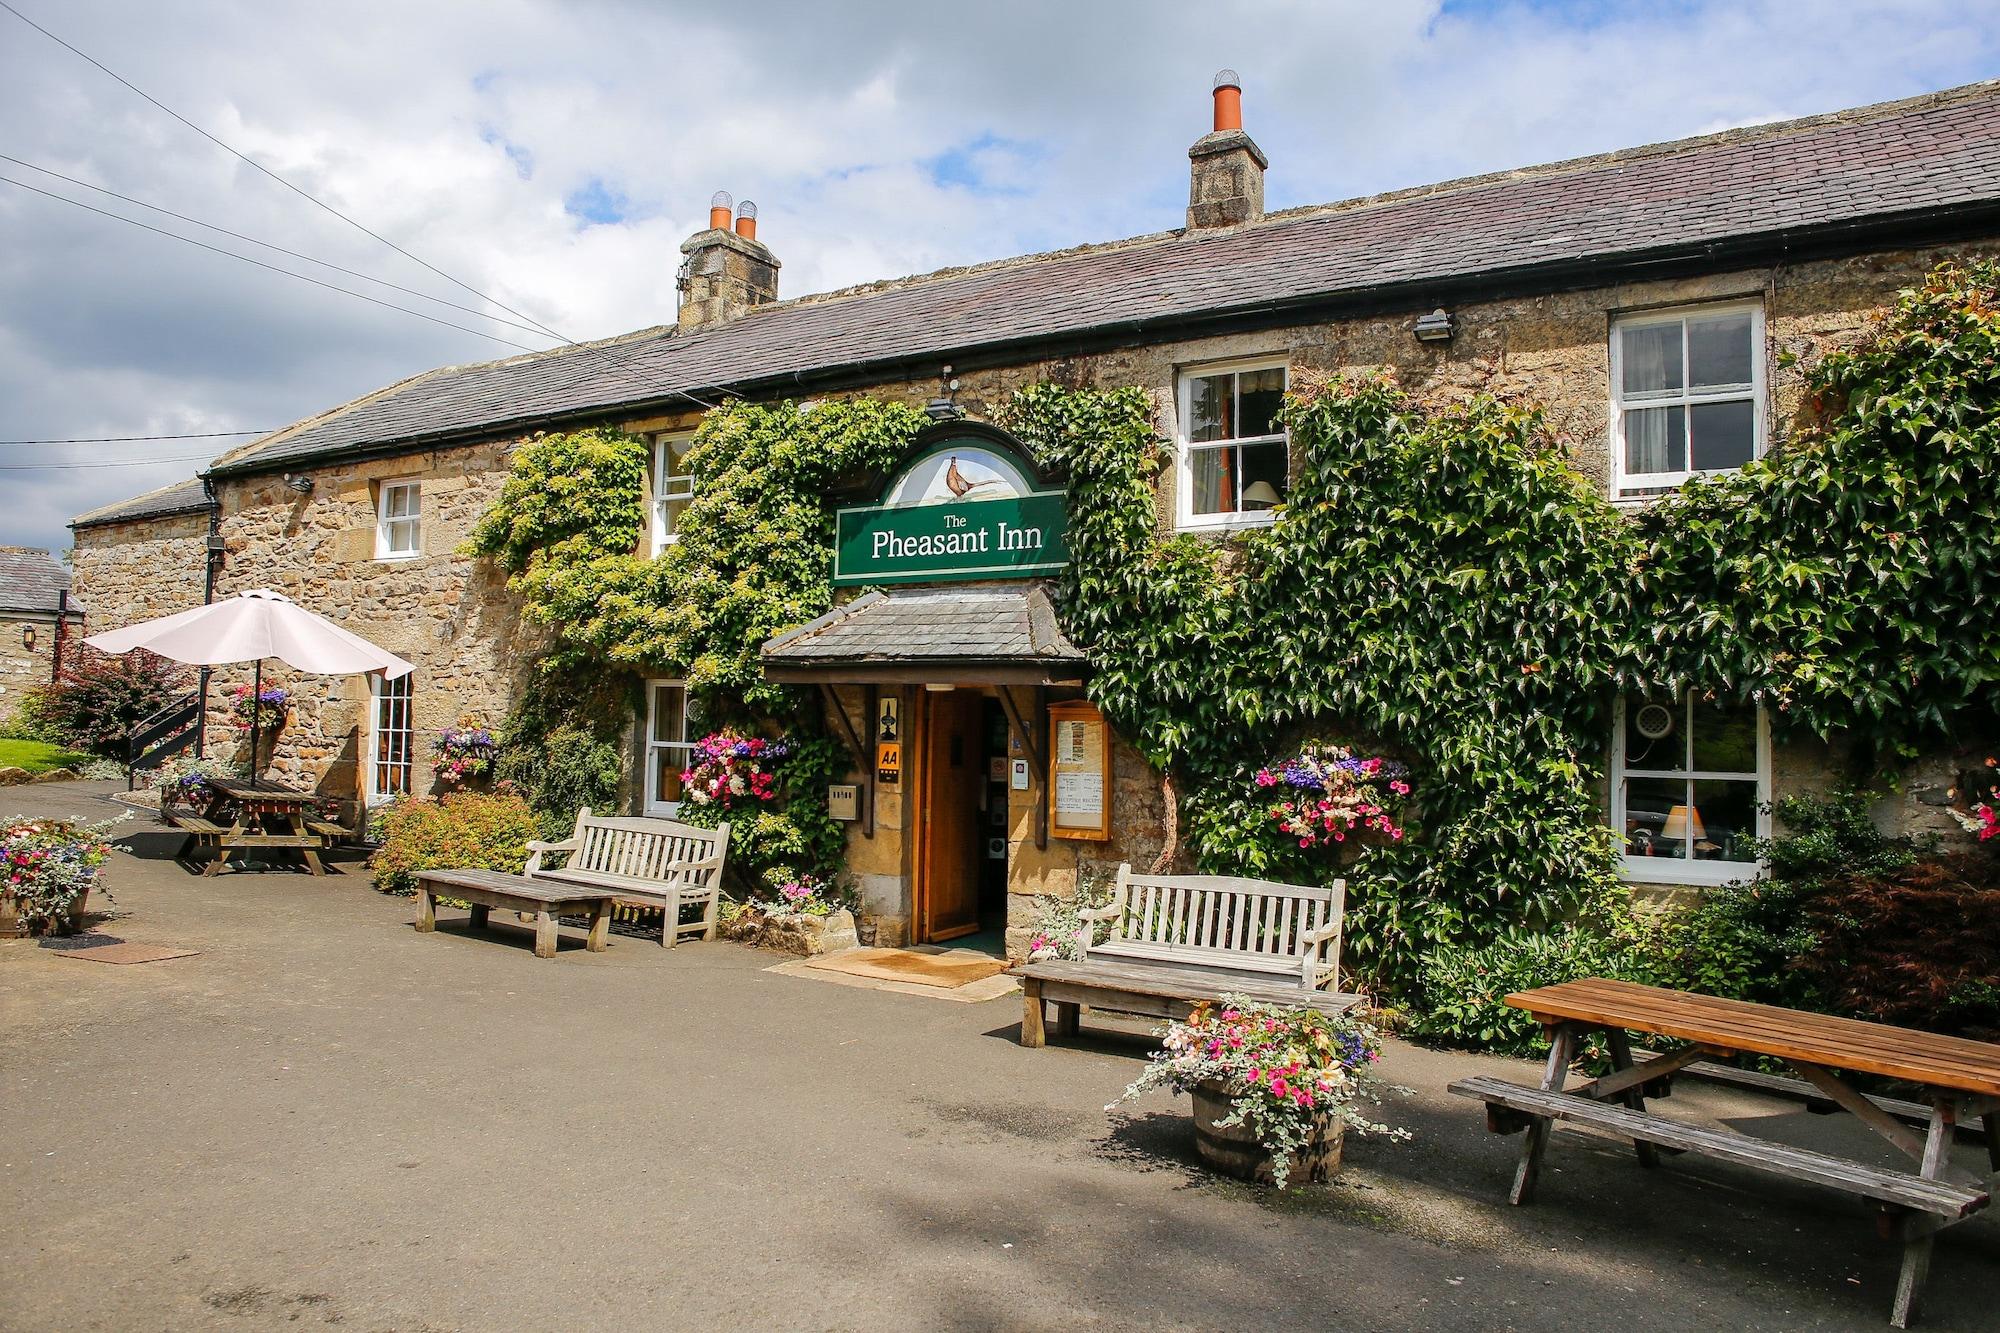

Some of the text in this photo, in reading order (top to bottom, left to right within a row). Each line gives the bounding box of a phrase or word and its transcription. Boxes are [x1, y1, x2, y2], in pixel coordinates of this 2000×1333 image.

[944, 515, 966, 528] The
[871, 522, 1042, 558] Pheasant Inn
[881, 750, 897, 765] AA
